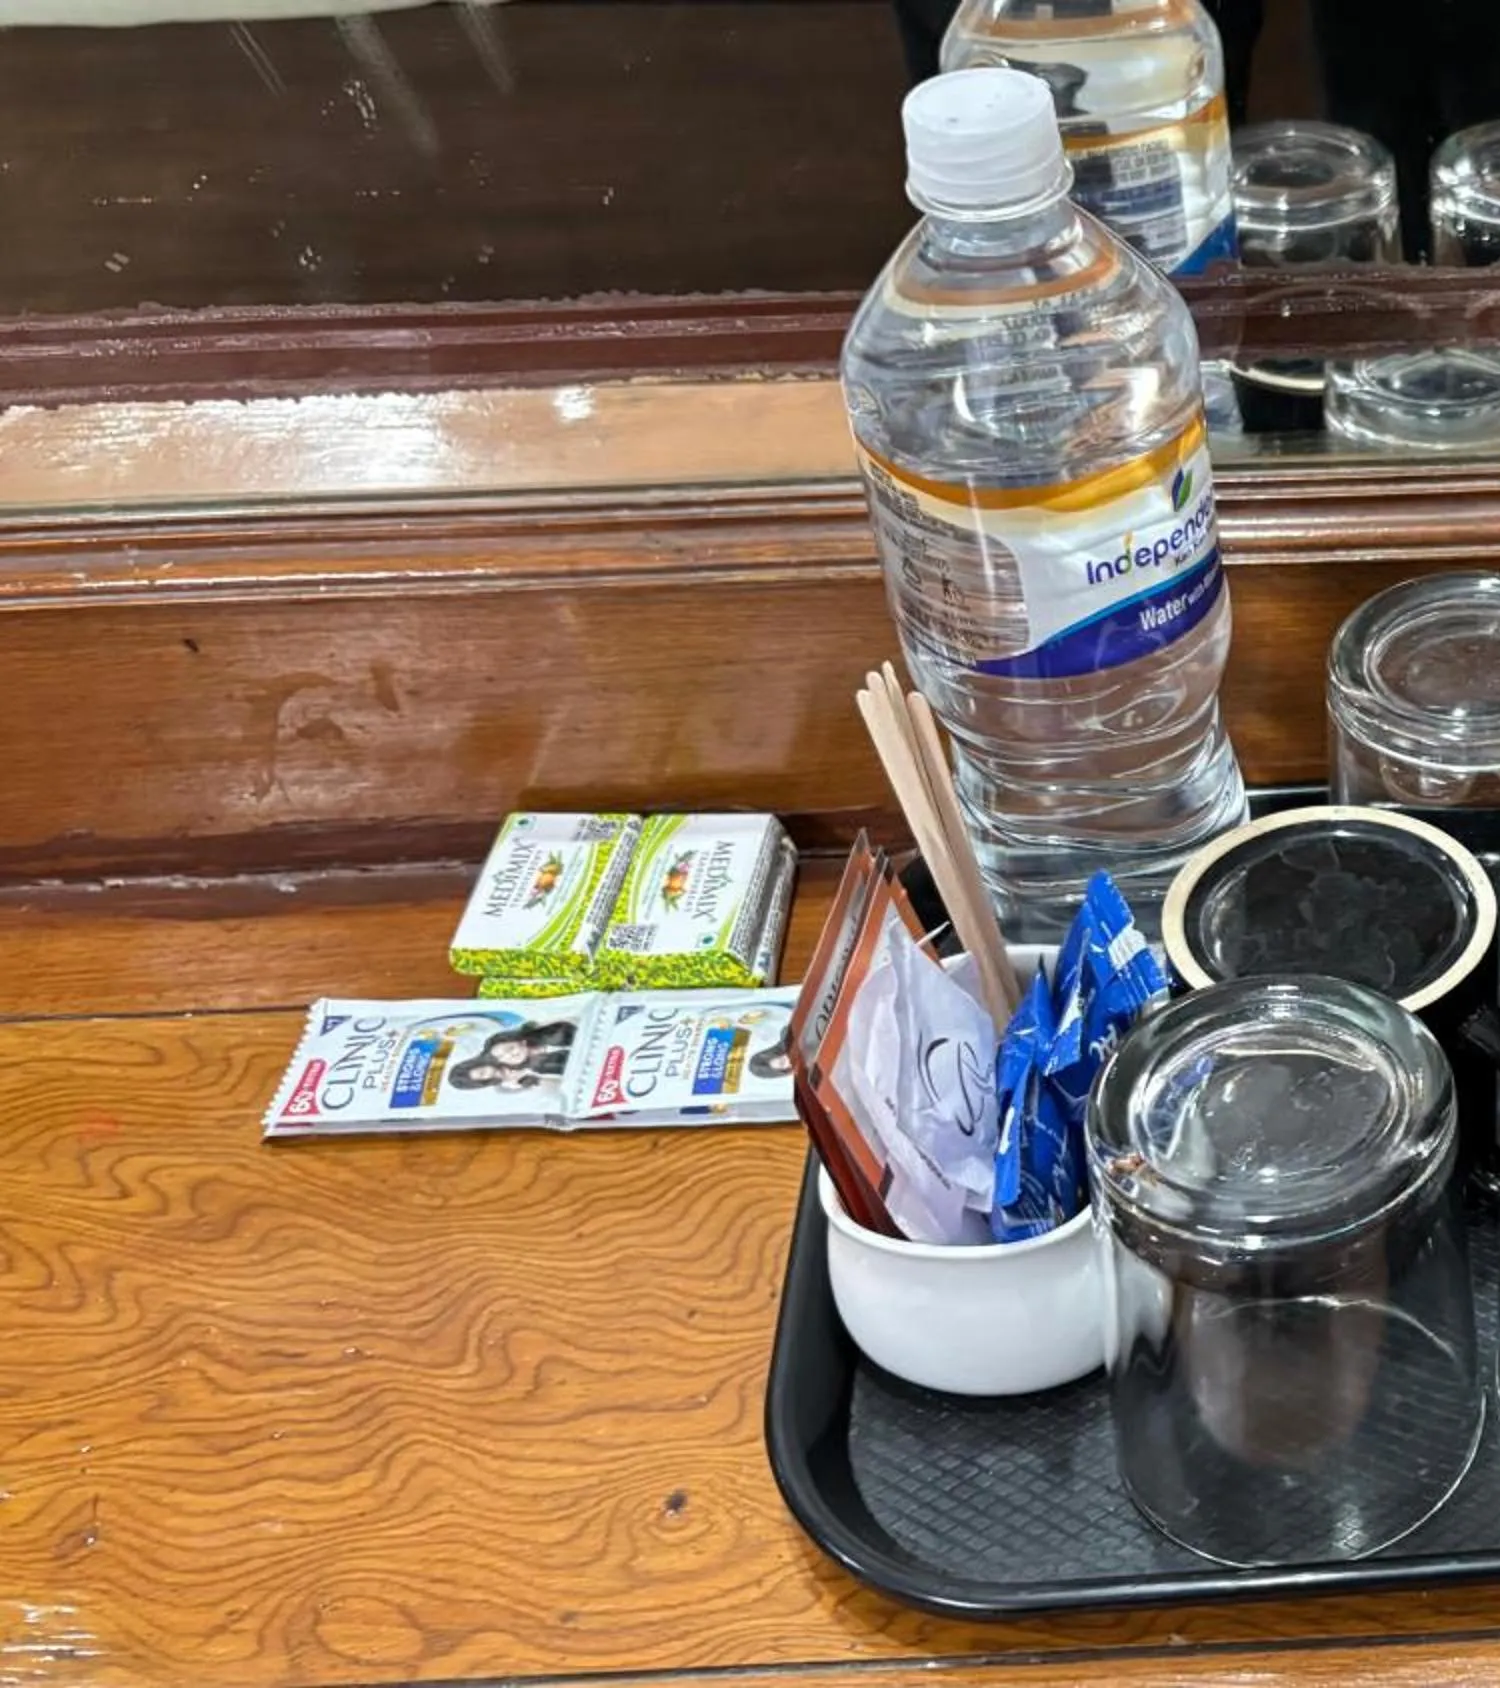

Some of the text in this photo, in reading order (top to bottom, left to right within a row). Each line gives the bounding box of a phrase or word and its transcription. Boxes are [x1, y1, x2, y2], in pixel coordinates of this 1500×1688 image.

[1139, 593, 1188, 631] Water
[482, 838, 535, 918] MEDIMIX
[692, 839, 735, 922] MEDIMIX
[321, 1016, 387, 1110] CLINIC
[626, 1008, 679, 1097] CLINIC
